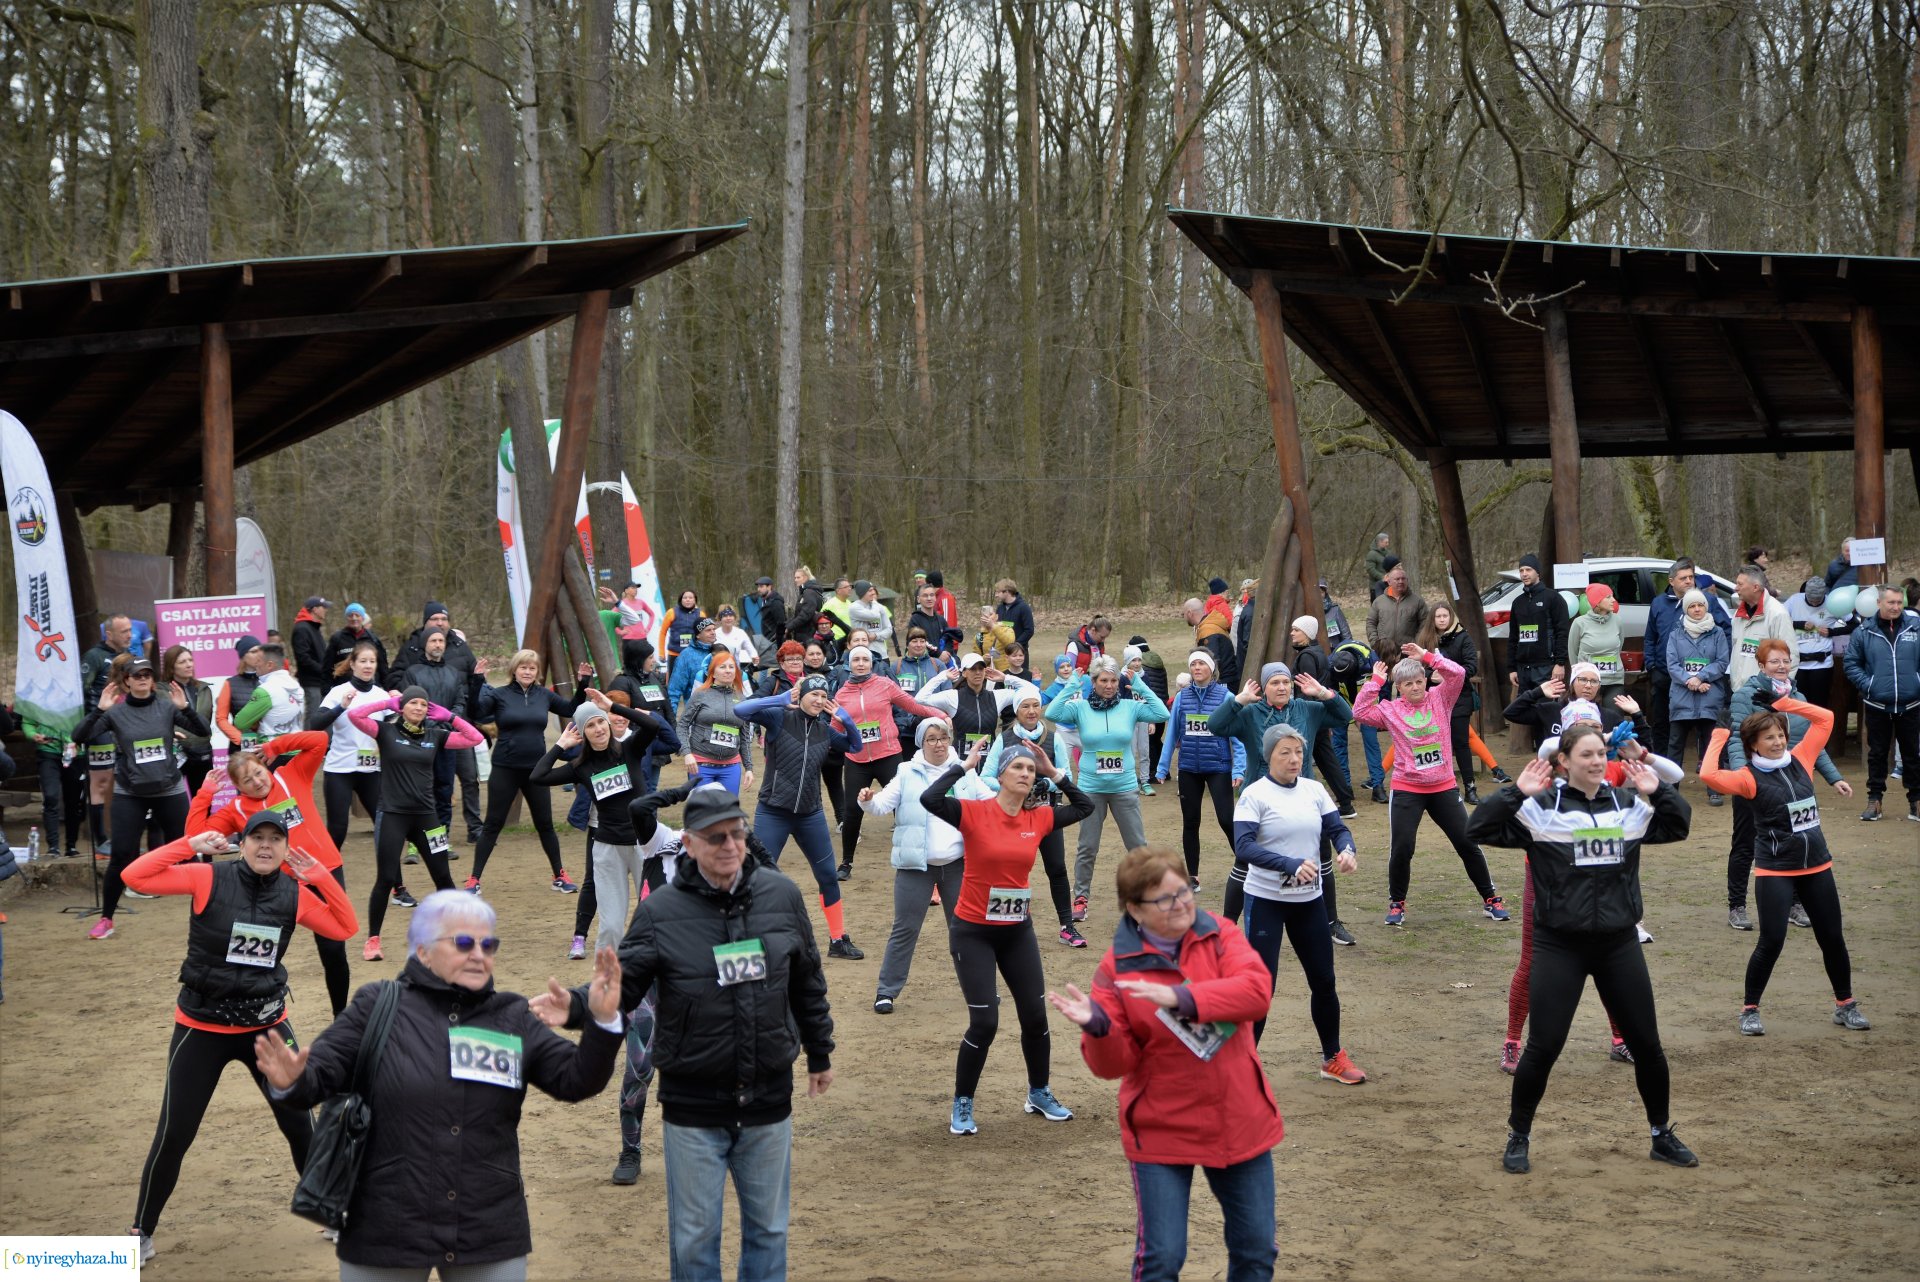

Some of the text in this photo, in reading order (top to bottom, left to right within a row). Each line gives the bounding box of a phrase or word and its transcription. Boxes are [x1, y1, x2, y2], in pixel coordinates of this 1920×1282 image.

[161, 605, 261, 622] CSATLAKOZZ
[175, 620, 251, 637] HOZZÁNK
[1520, 630, 1535, 639] 161
[179, 638, 215, 652] MÉG
[1187, 720, 1208, 732] 150
[90, 750, 112, 761] 128
[1099, 757, 1122, 769] 106
[1416, 750, 1440, 765] 105
[595, 774, 624, 794] 020
[1792, 805, 1816, 825] 227
[1577, 837, 1615, 857] 101
[989, 897, 1023, 914] 218
[231, 934, 275, 957] 229
[722, 954, 765, 982] 025
[454, 1042, 510, 1073] 026
